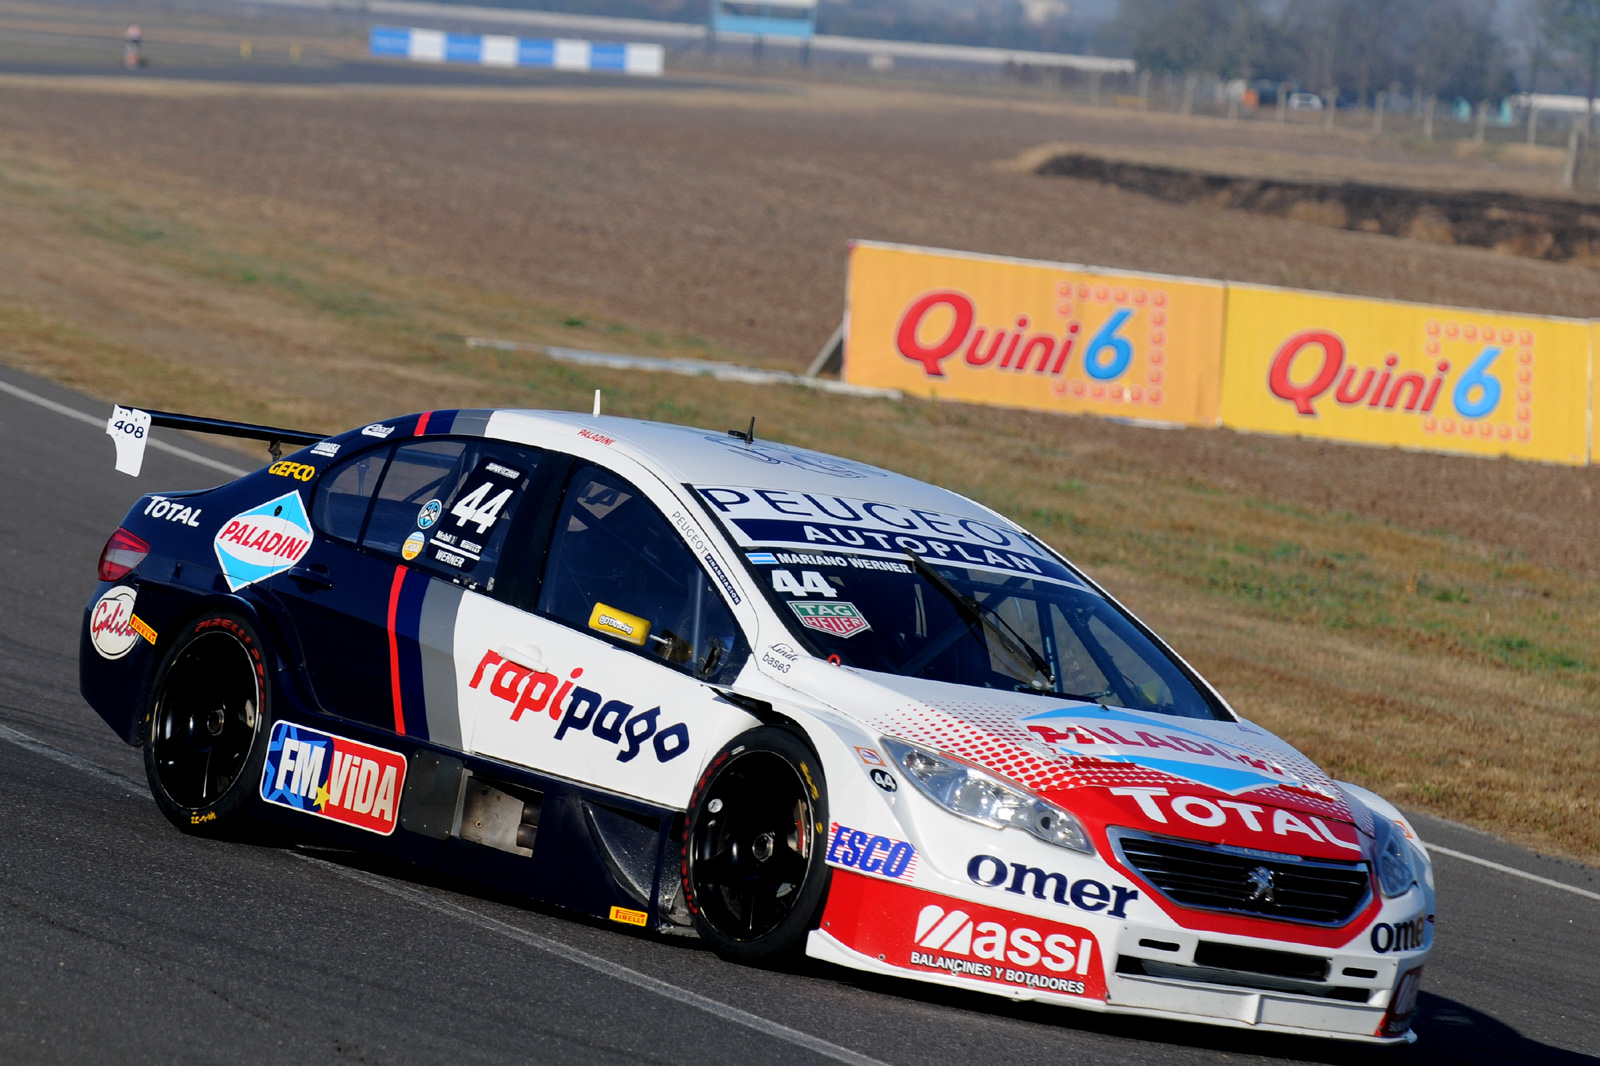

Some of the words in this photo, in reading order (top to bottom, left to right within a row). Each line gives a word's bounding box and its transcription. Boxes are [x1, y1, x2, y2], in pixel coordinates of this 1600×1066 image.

[897, 293, 1079, 377] Quini
[1084, 307, 1135, 381] 6
[1268, 332, 1449, 416] Quini
[1452, 346, 1502, 419] 6
[113, 419, 145, 440] 408
[577, 429, 617, 446] PALADINI
[268, 460, 315, 481] GEFCO
[143, 495, 203, 528] TOTAL
[450, 482, 514, 534] 44
[696, 488, 1044, 557] PEUGEOT
[219, 520, 309, 561] PALADINI
[671, 511, 709, 555] PEUGEOT
[803, 525, 1043, 574] AUTOPLAN
[435, 549, 466, 568] WERNER
[776, 553, 848, 567] MARIANO
[849, 558, 913, 574] WERNER
[771, 569, 838, 597] 44
[798, 605, 853, 616] TAG
[805, 617, 863, 634] HEUER
[762, 652, 791, 674] base3
[768, 642, 799, 663] Linde
[468, 649, 690, 763] rapipago
[275, 737, 326, 799] FM
[874, 772, 896, 790] 44
[1109, 787, 1361, 852] TOTAL
[827, 825, 915, 878] ESCO
[966, 854, 1139, 919] omer
[614, 907, 646, 924] PIRELLI
[910, 951, 992, 978] BALANCINES
[994, 966, 1004, 979] Y
[1005, 969, 1085, 995] BOTADORES
